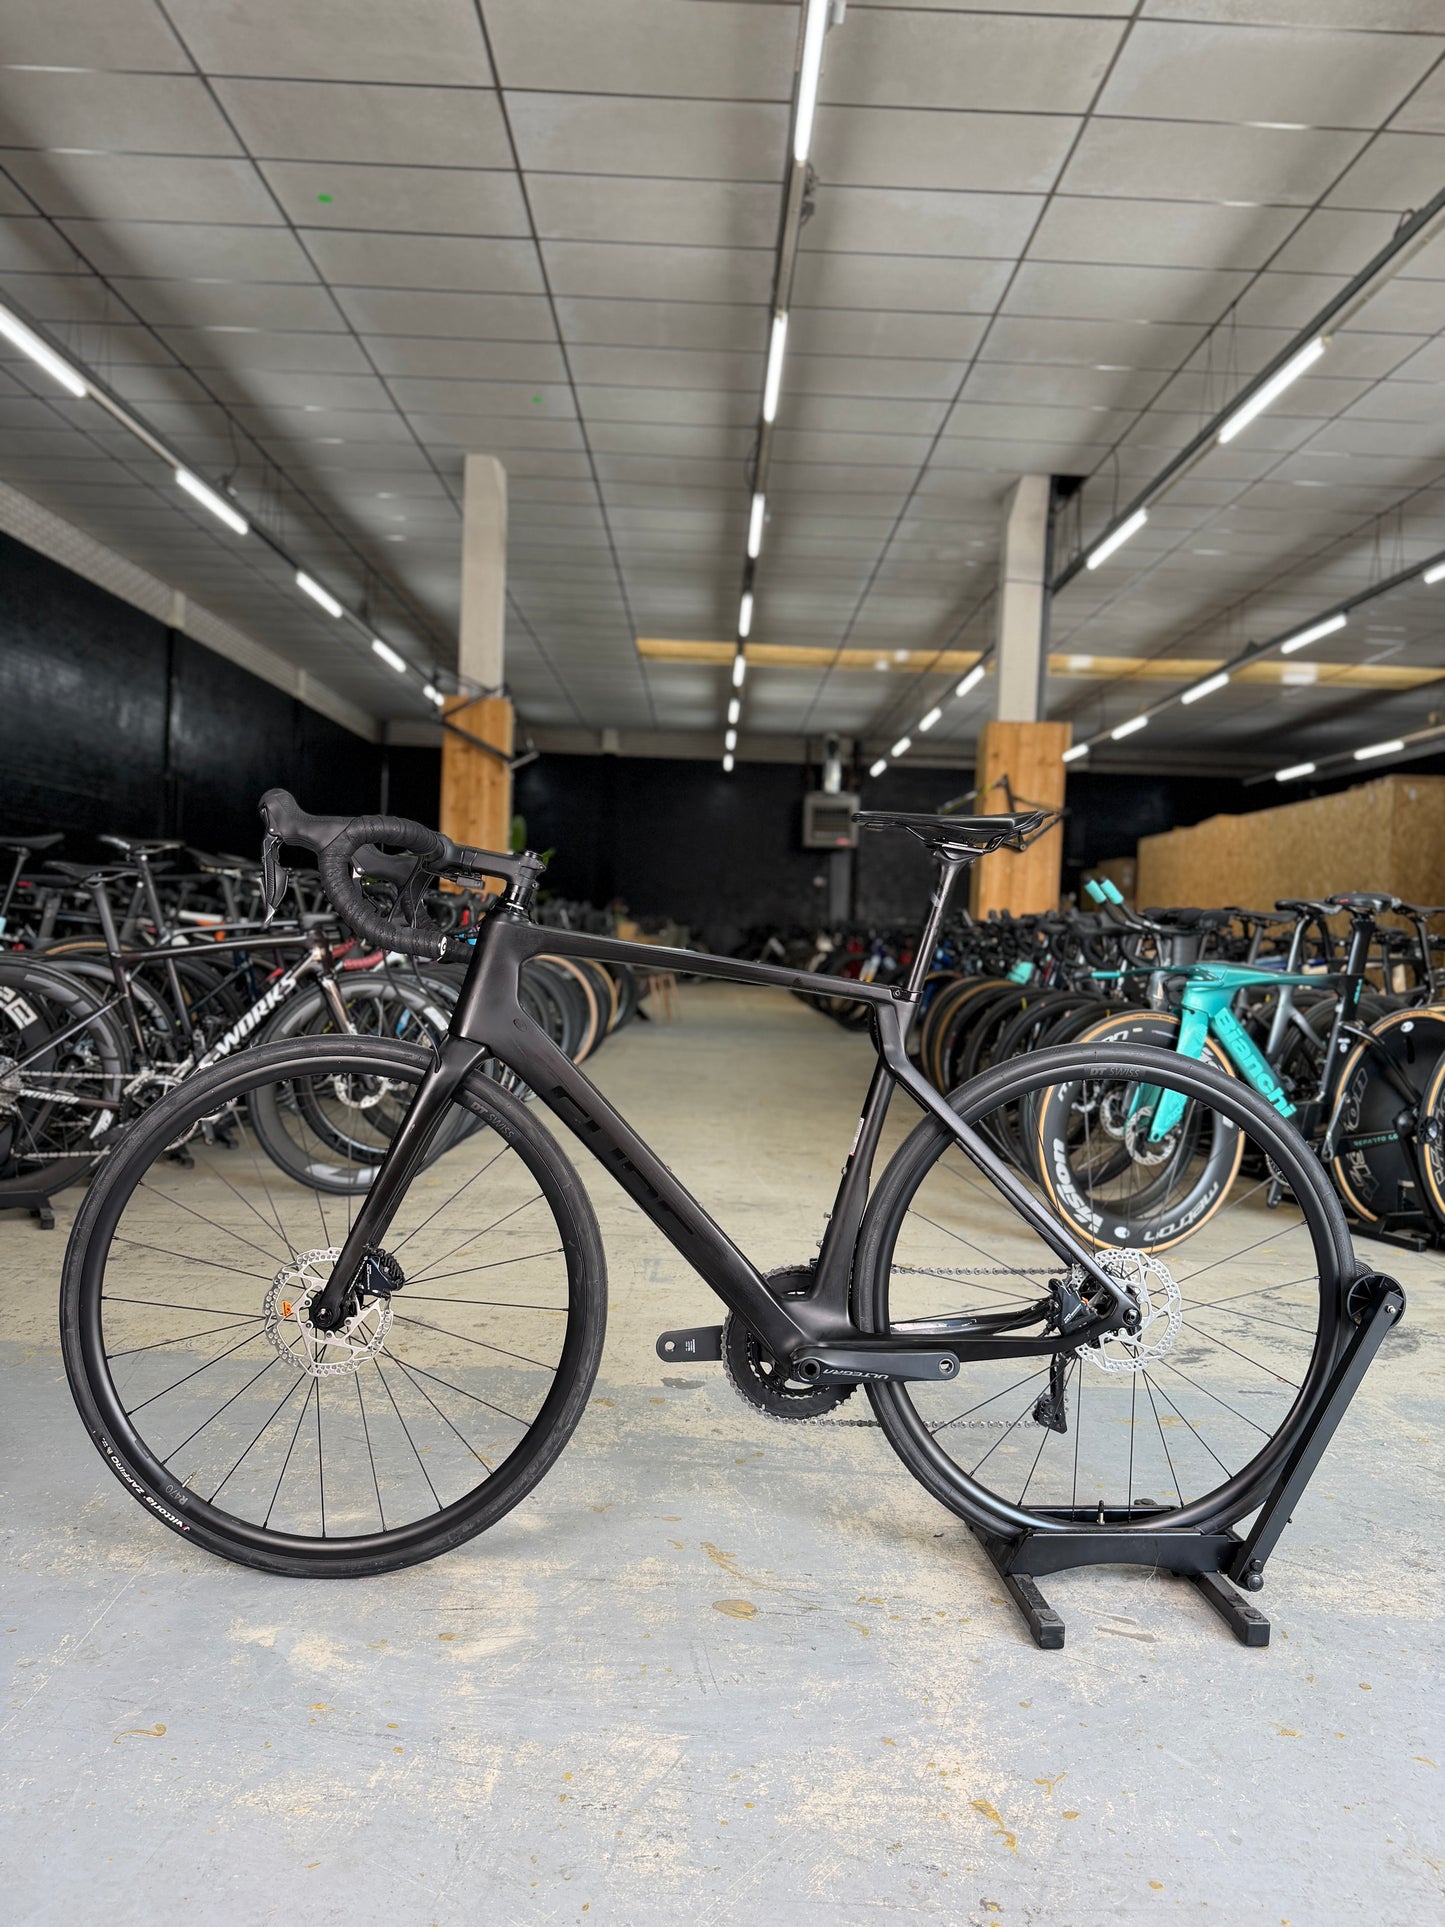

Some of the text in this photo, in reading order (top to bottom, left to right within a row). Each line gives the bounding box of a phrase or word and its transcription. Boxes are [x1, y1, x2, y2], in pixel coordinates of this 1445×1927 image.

[1089, 1066, 1141, 1078] DT SWISS
[1214, 1007, 1298, 1118] Bianchi
[470, 1101, 515, 1138] DT SWISS
[823, 1368, 889, 1380] ULTEGRA
[111, 1455, 145, 1494] ZAFFIRO
[165, 1483, 189, 1507] R470
